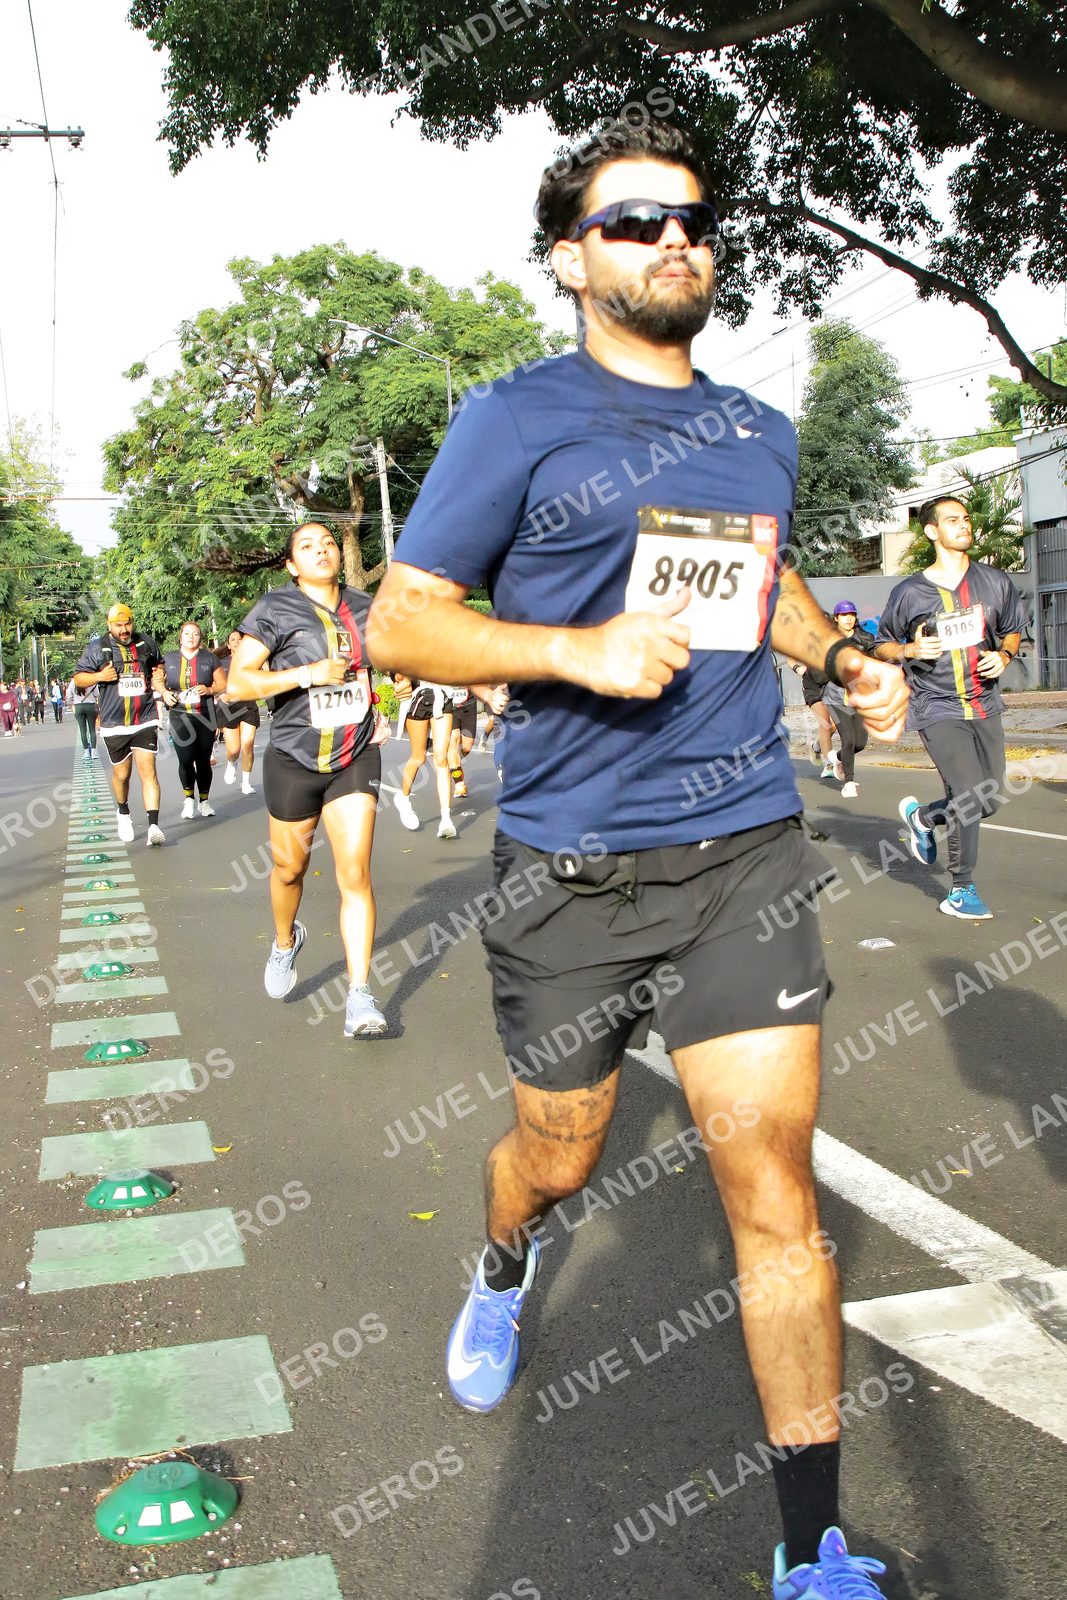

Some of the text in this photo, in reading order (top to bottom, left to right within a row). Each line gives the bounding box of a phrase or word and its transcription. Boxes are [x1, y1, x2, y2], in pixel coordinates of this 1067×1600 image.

[648, 555, 744, 600] 8905
[944, 620, 974, 636] 8105
[313, 688, 364, 710] 12704
